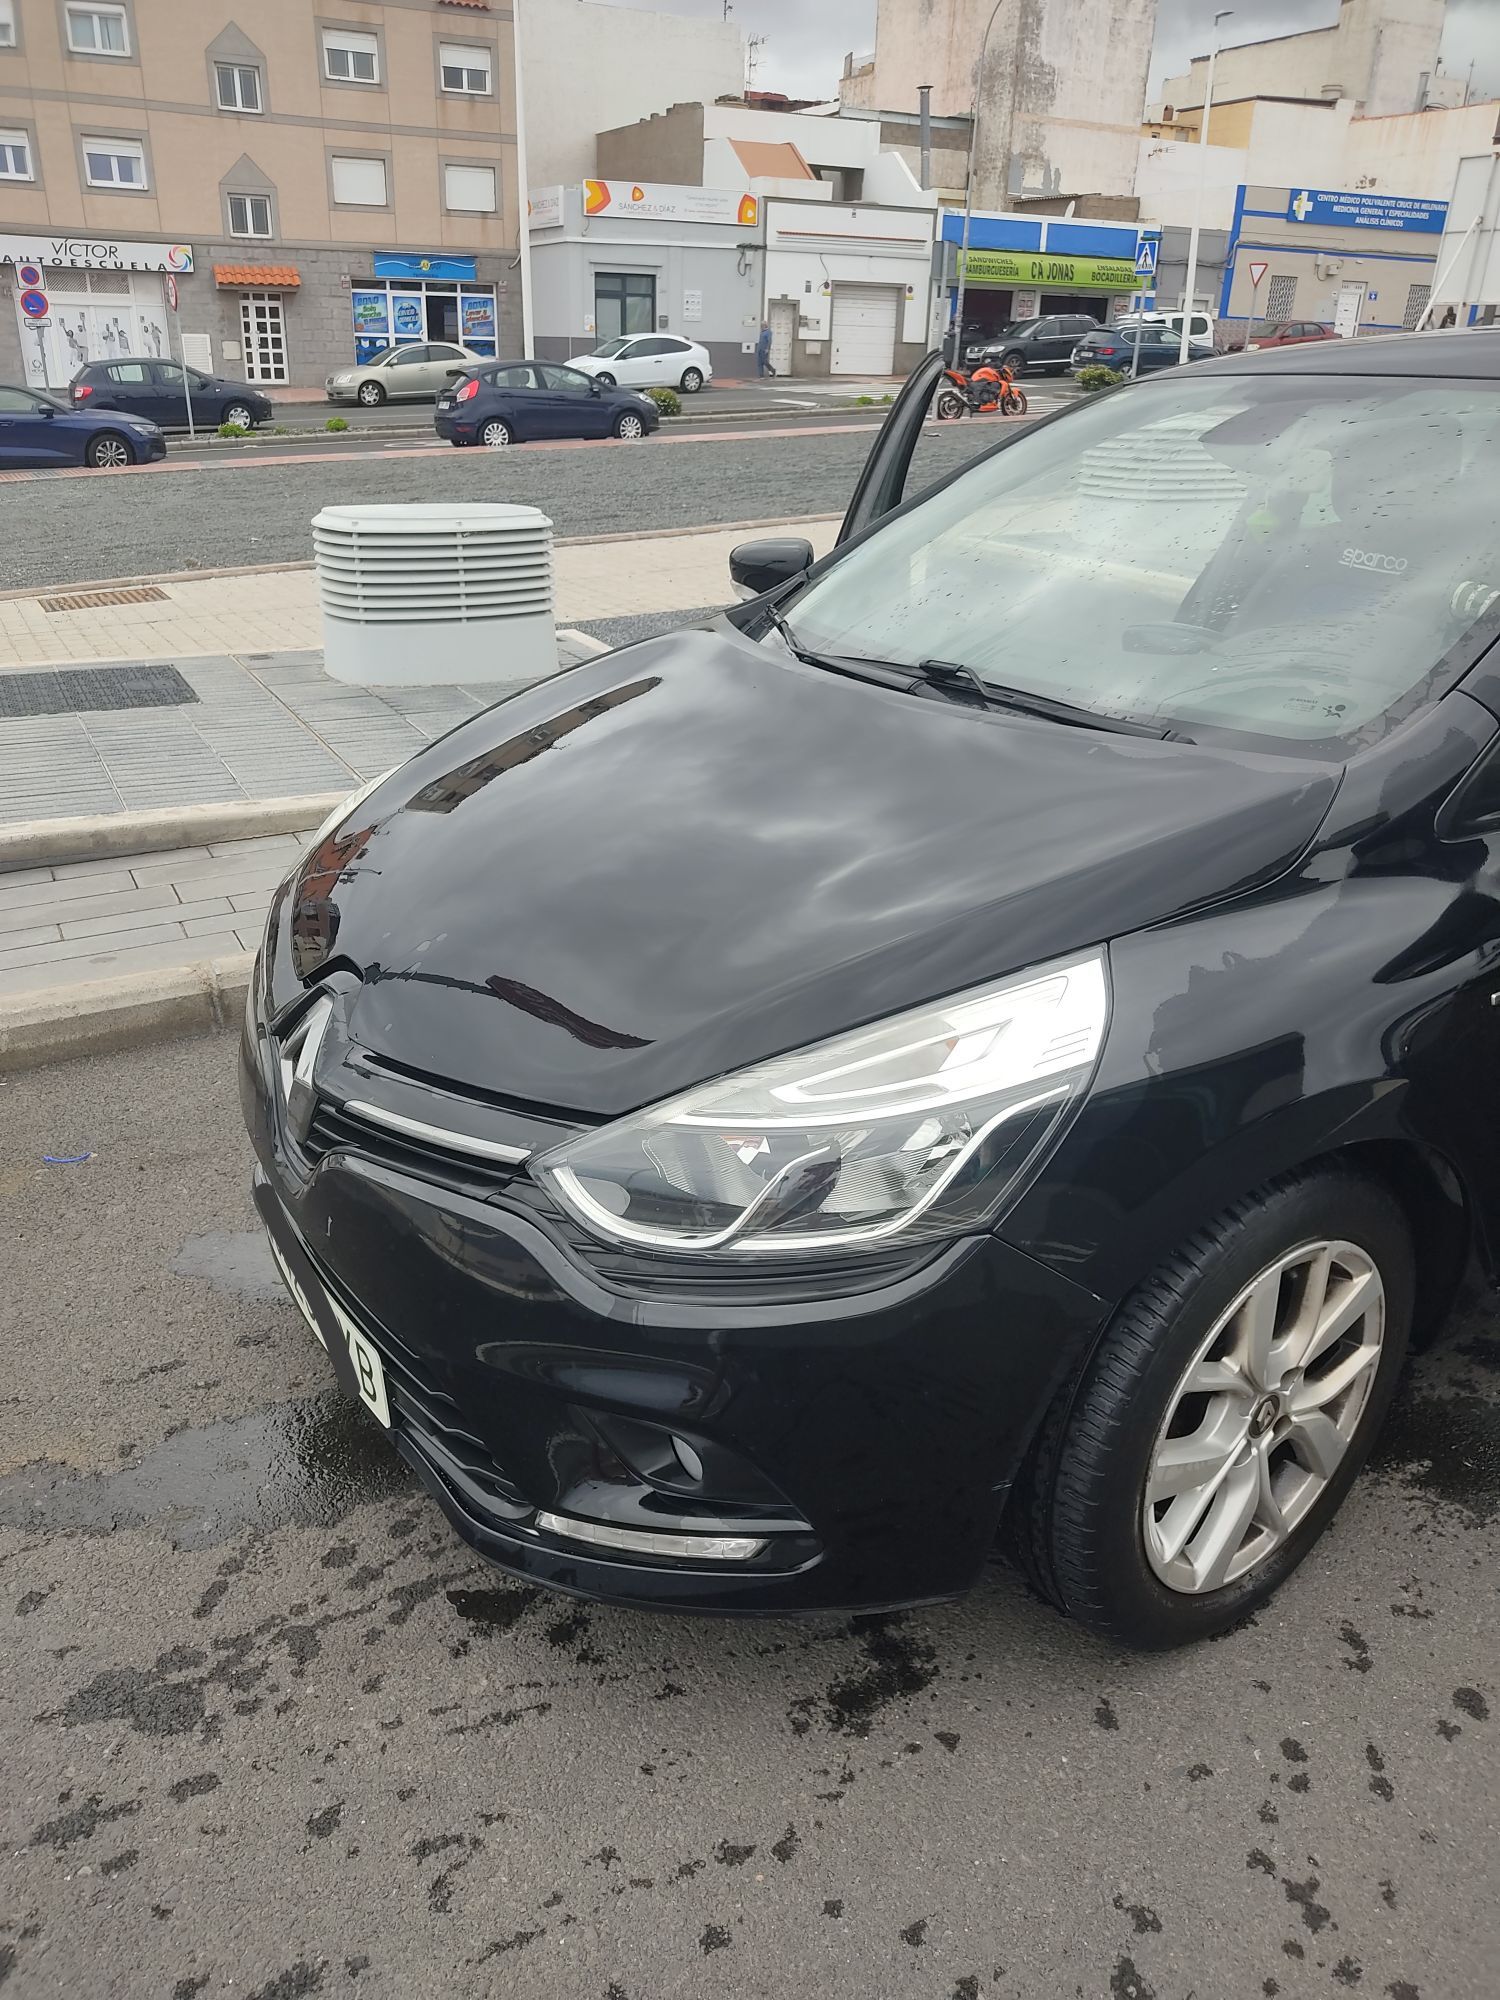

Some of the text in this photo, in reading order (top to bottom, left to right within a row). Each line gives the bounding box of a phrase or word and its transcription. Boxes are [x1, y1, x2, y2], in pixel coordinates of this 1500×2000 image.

[1317, 193, 1339, 203] CENTRO
[1361, 197, 1396, 208] POLIVALENTE
[1413, 202, 1421, 210] DE
[1333, 205, 1359, 214] MEDICINA
[1360, 207, 1384, 216] GENERAL
[1389, 210, 1429, 219] ESPECIALIDADES
[1355, 216, 1404, 227] ANÁLISIS CLÍNICOS
[51, 238, 119, 259] VÍCTOR
[3, 255, 168, 271] AUTOESCUELA
[1046, 262, 1075, 282] JONAS
[1342, 548, 1408, 570] sparco
